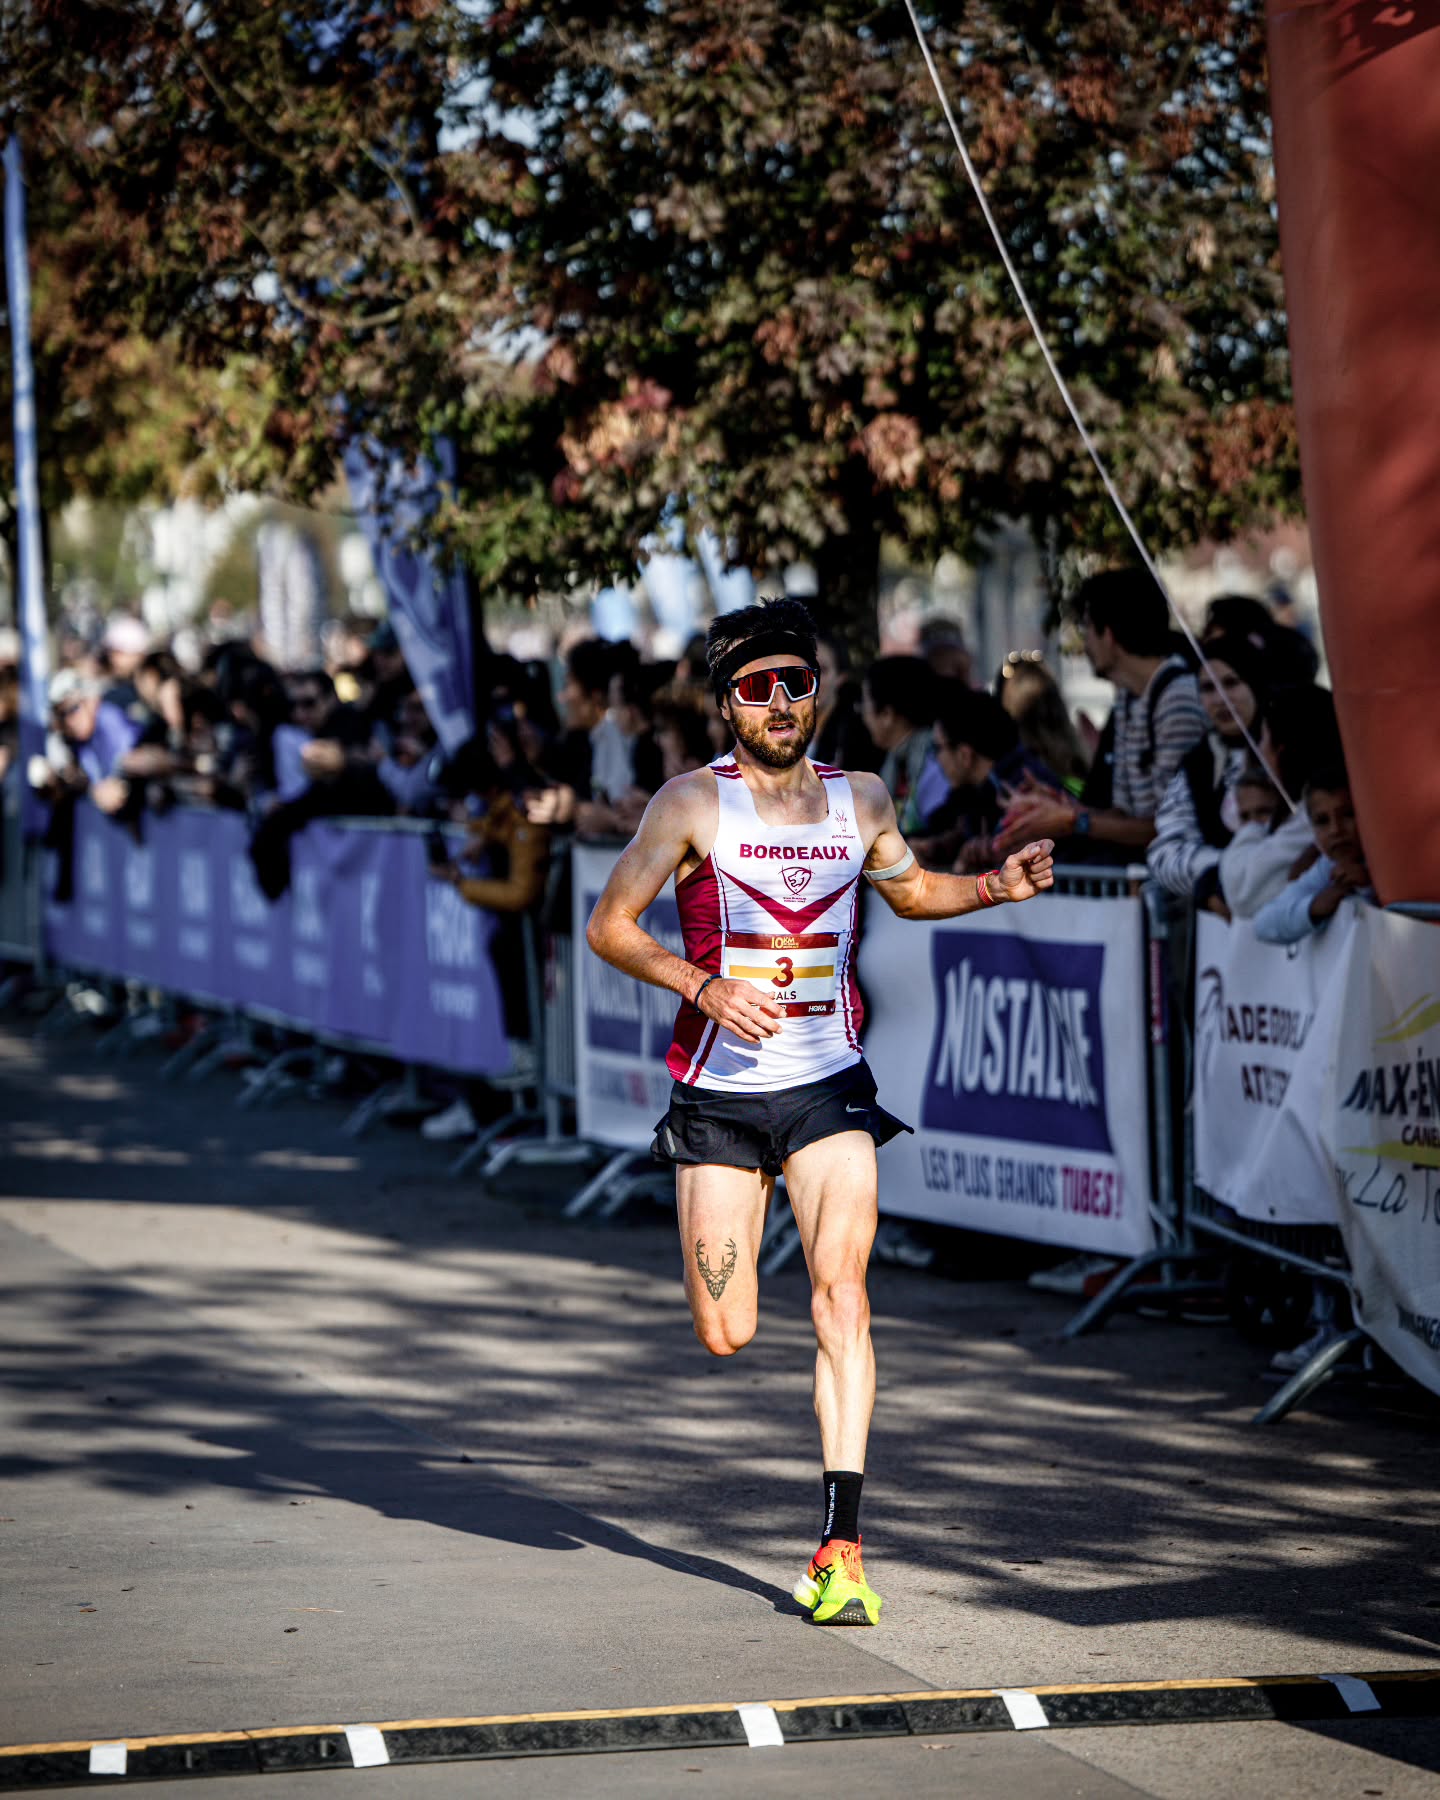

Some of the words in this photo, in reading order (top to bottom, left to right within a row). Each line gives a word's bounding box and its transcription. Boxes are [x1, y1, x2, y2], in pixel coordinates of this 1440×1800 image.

[739, 843, 850, 860] BORDEAUX
[771, 957, 794, 988] 3
[773, 990, 797, 1000] ALS
[808, 1004, 827, 1013] HOKA
[920, 1146, 951, 1193] LES
[952, 1151, 992, 1199] PLUS
[995, 1157, 1057, 1210] GRANDS
